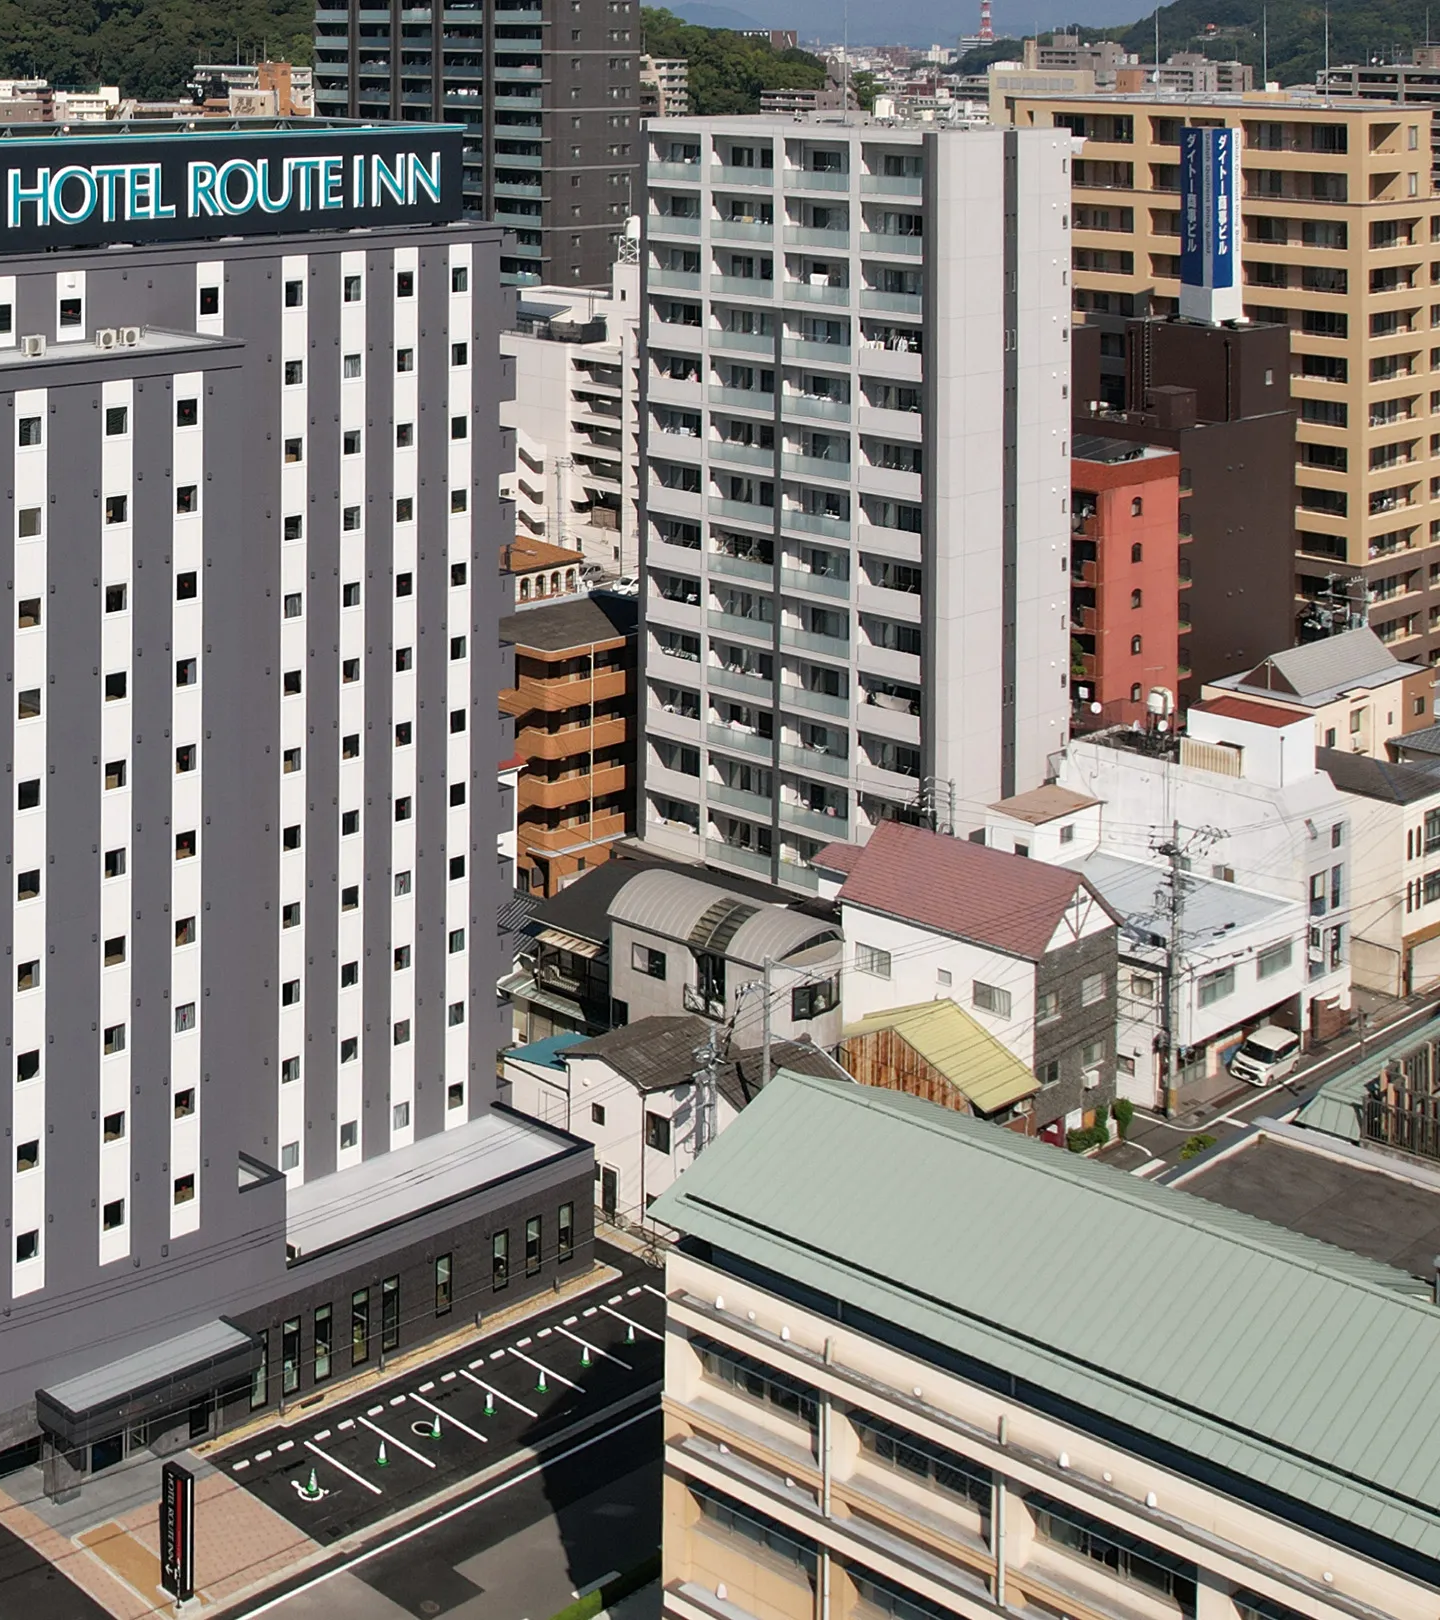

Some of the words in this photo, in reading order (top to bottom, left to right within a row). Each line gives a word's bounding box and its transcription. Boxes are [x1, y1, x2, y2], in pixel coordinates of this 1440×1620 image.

[7, 162, 176, 228] HOTEL
[187, 155, 343, 218] ROUTE
[353, 151, 441, 208] INN
